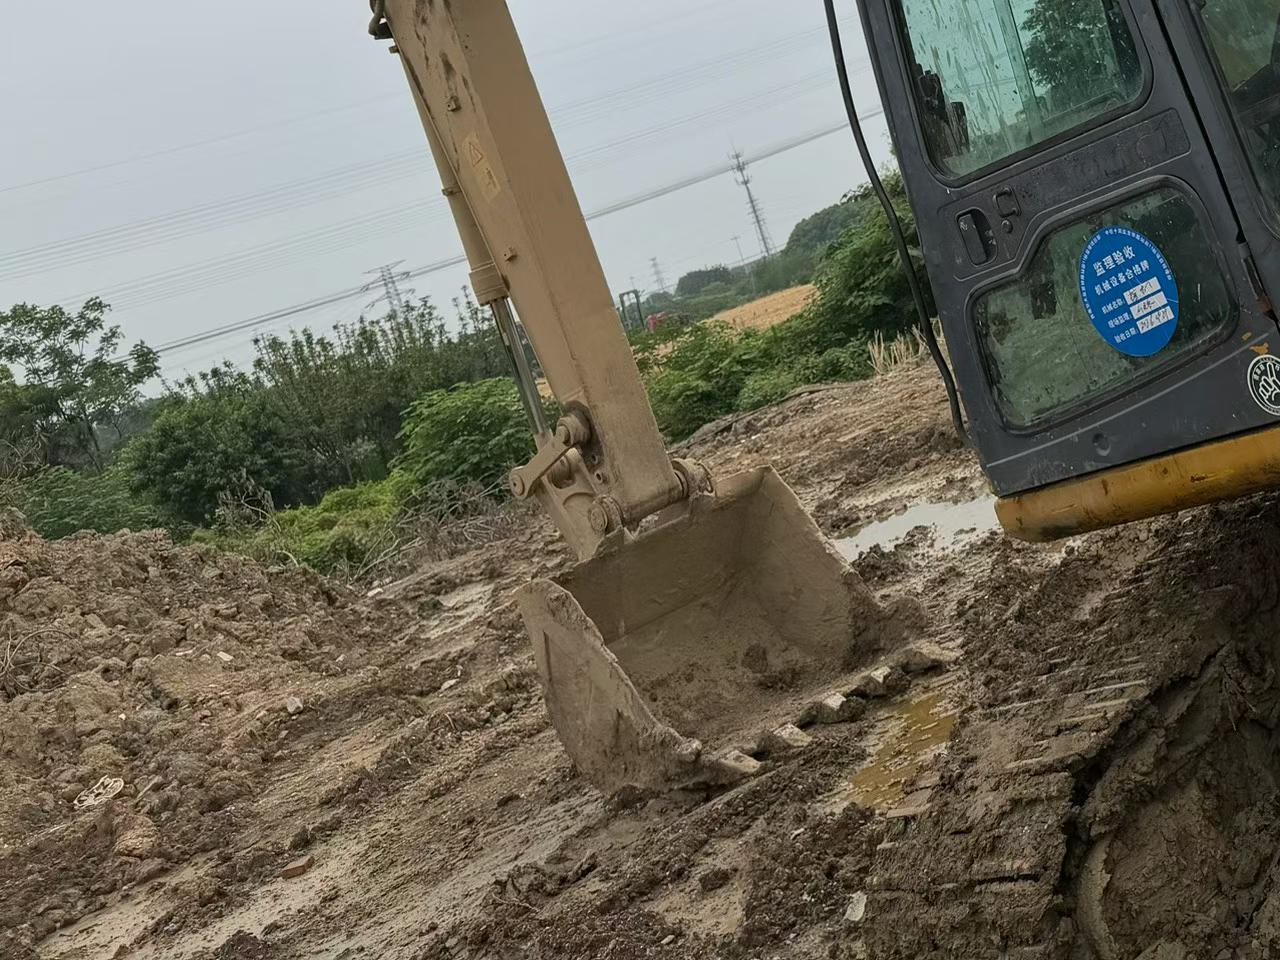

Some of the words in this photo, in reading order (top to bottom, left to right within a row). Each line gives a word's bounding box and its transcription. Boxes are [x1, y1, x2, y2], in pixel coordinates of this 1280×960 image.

[1091, 244, 1137, 276] 监理验收
[1093, 259, 1151, 296] 机械设备合格牌
